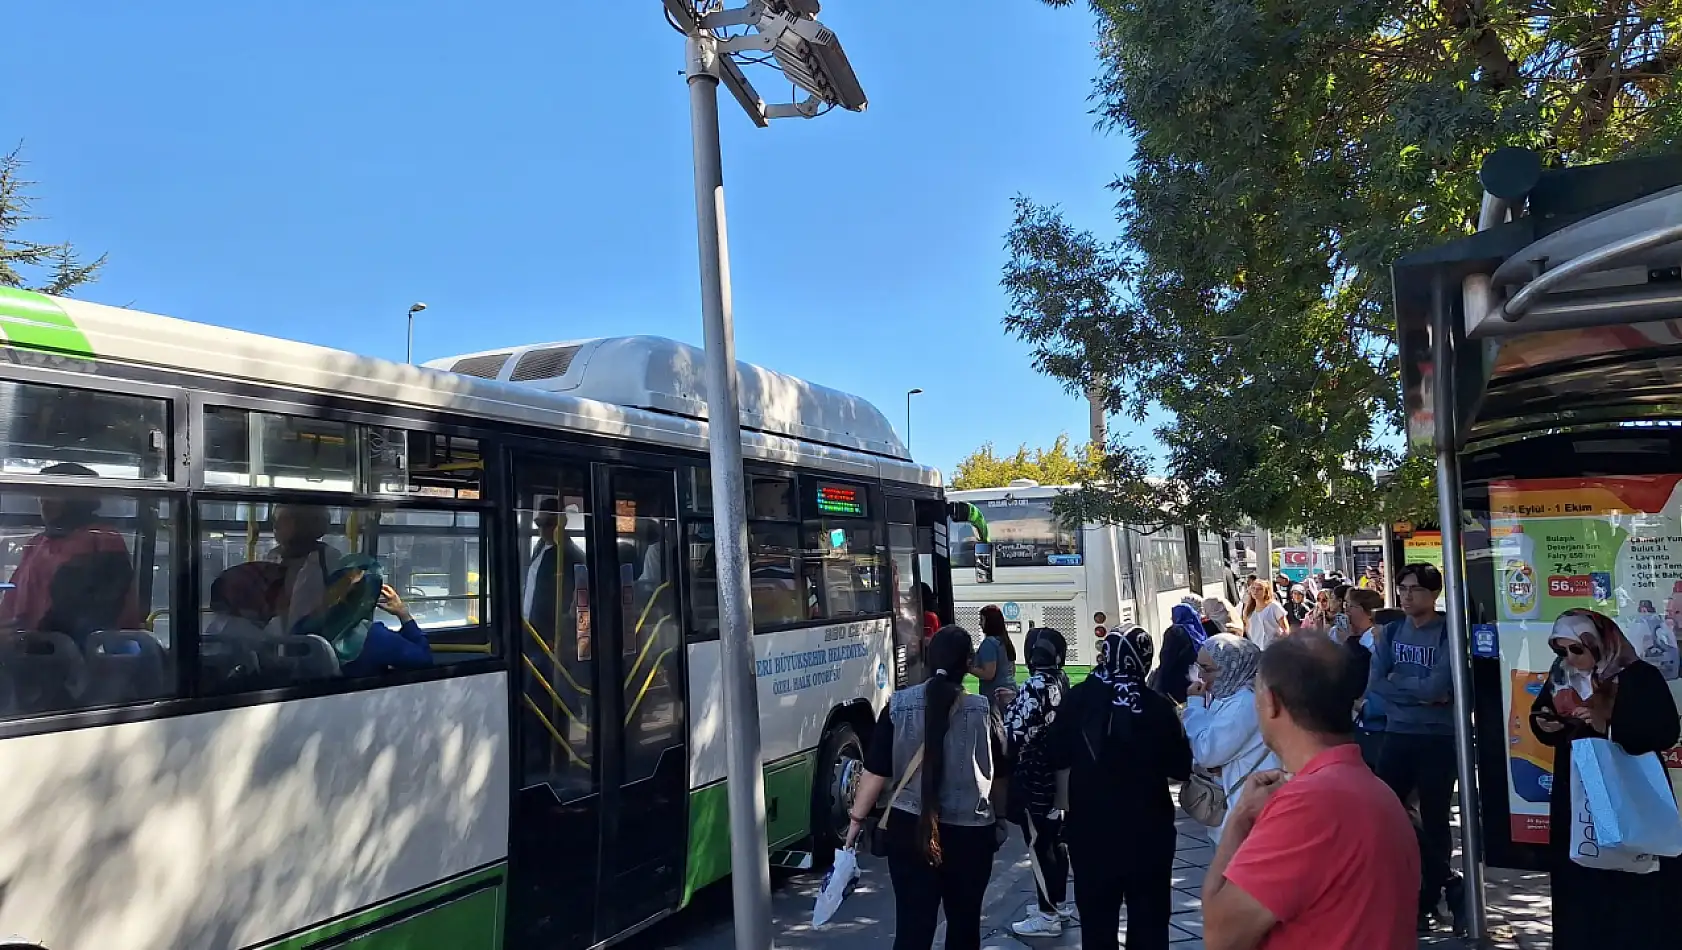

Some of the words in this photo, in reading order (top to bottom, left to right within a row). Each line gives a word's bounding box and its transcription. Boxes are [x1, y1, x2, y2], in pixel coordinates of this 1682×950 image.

[1518, 504, 1545, 515] Eylül
[1555, 504, 1561, 512] 1
[1564, 503, 1592, 512] Ekim
[1551, 580, 1574, 592] 56,
[756, 652, 773, 678] ERİ
[775, 645, 827, 673] BÜYÜKŞEHİR
[828, 639, 868, 661] BELEDİYESİ
